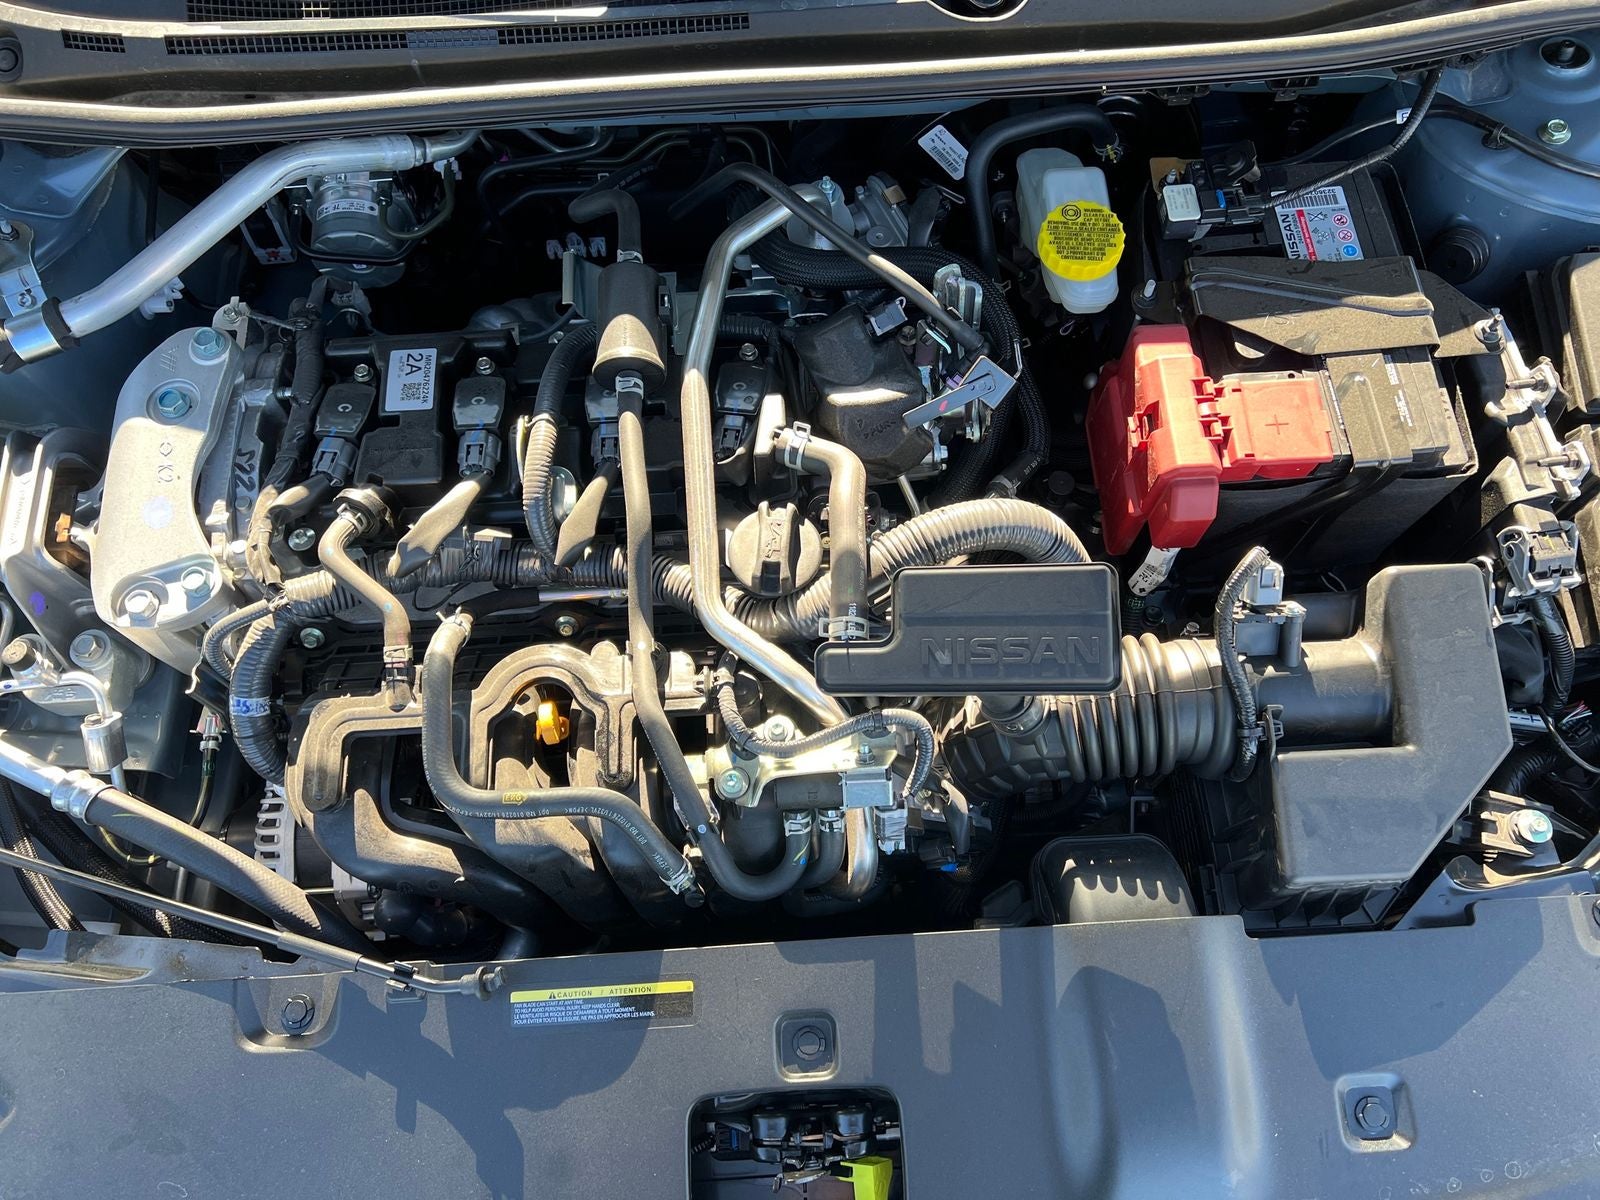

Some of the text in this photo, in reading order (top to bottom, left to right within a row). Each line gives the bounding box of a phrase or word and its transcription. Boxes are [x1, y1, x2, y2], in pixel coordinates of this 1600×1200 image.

[405, 353, 424, 376] 2A
[922, 636, 1100, 664] NISSAN
[557, 990, 592, 998] CAUTION
[610, 986, 652, 995] ATTENTION
